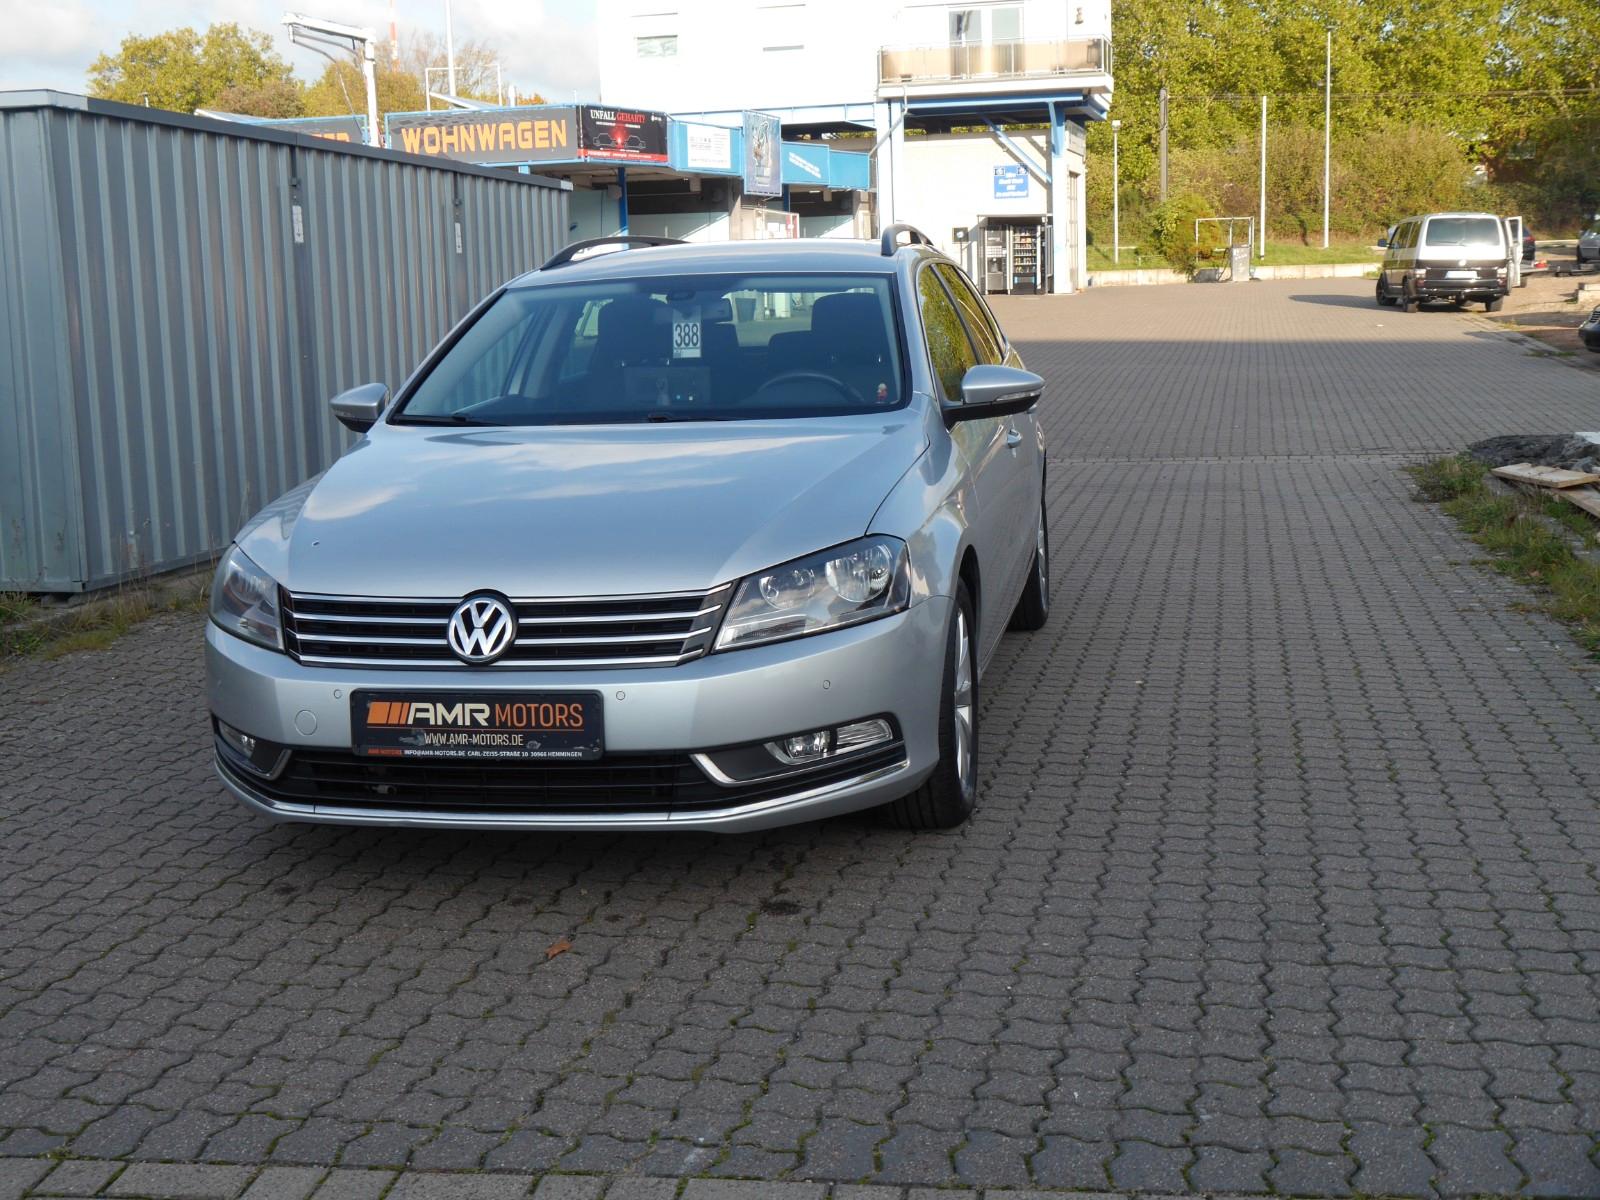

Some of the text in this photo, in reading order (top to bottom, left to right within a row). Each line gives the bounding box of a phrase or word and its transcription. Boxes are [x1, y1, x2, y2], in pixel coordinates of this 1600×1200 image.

[590, 109, 616, 121] UNFALL
[401, 119, 567, 155] WOHNWAGEN
[674, 323, 699, 347] 388
[407, 702, 584, 728] AMR MOTORS
[424, 732, 524, 747] WWW.AMR-MOTORS.DE
